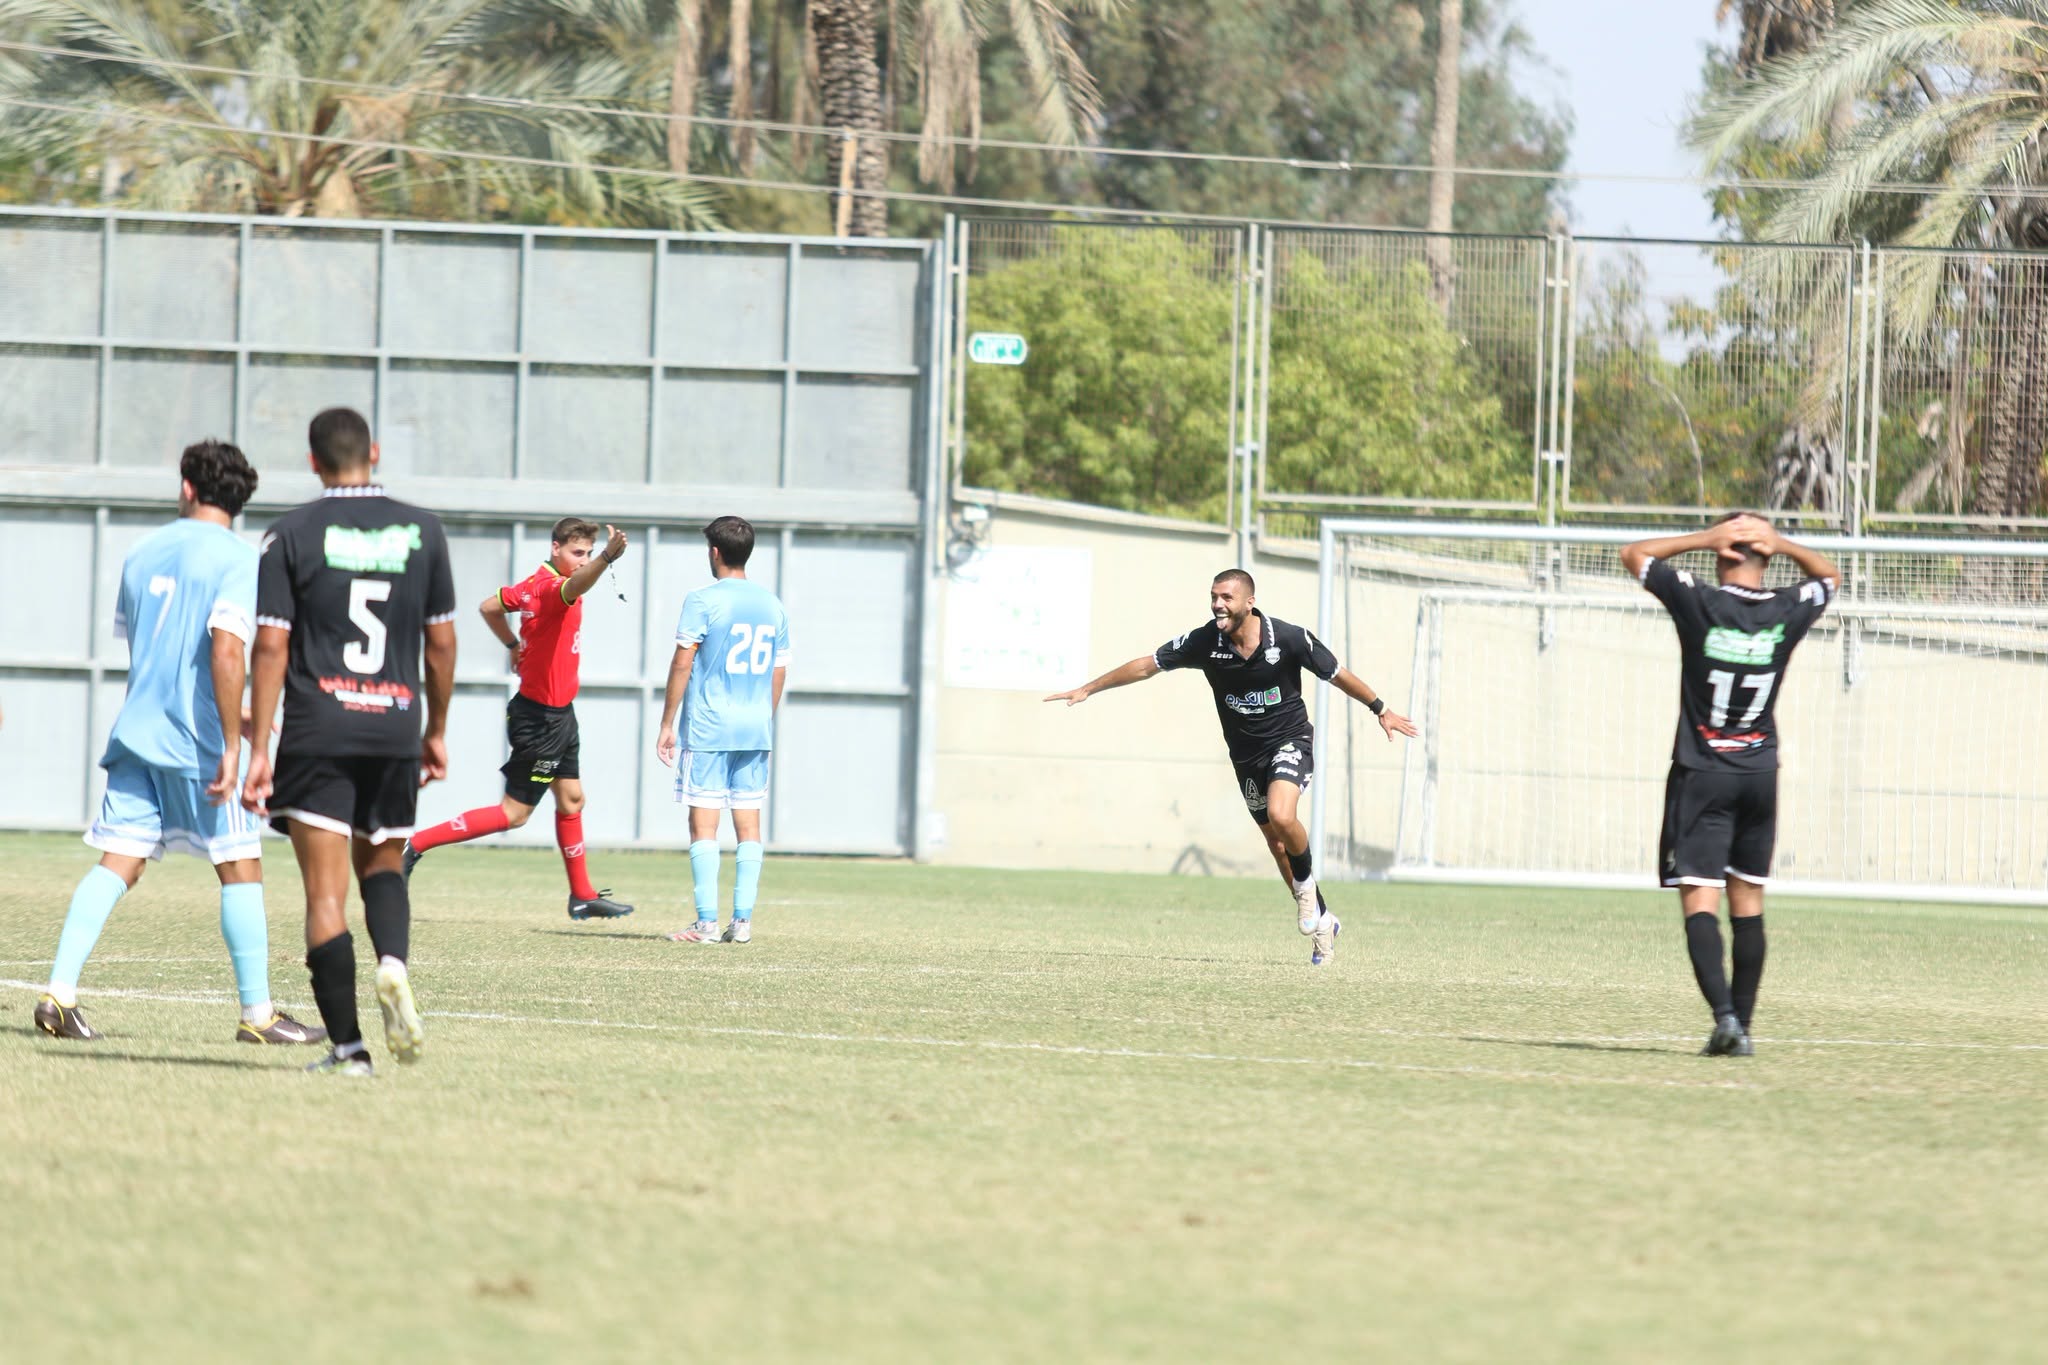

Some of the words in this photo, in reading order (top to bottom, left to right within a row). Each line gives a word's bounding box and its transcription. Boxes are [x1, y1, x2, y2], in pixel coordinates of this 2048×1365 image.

[148, 575, 176, 641] 7
[343, 578, 392, 675] 5
[725, 623, 776, 675] 26
[1210, 651, 1234, 660] Zeus
[1706, 669, 1777, 729] 17
